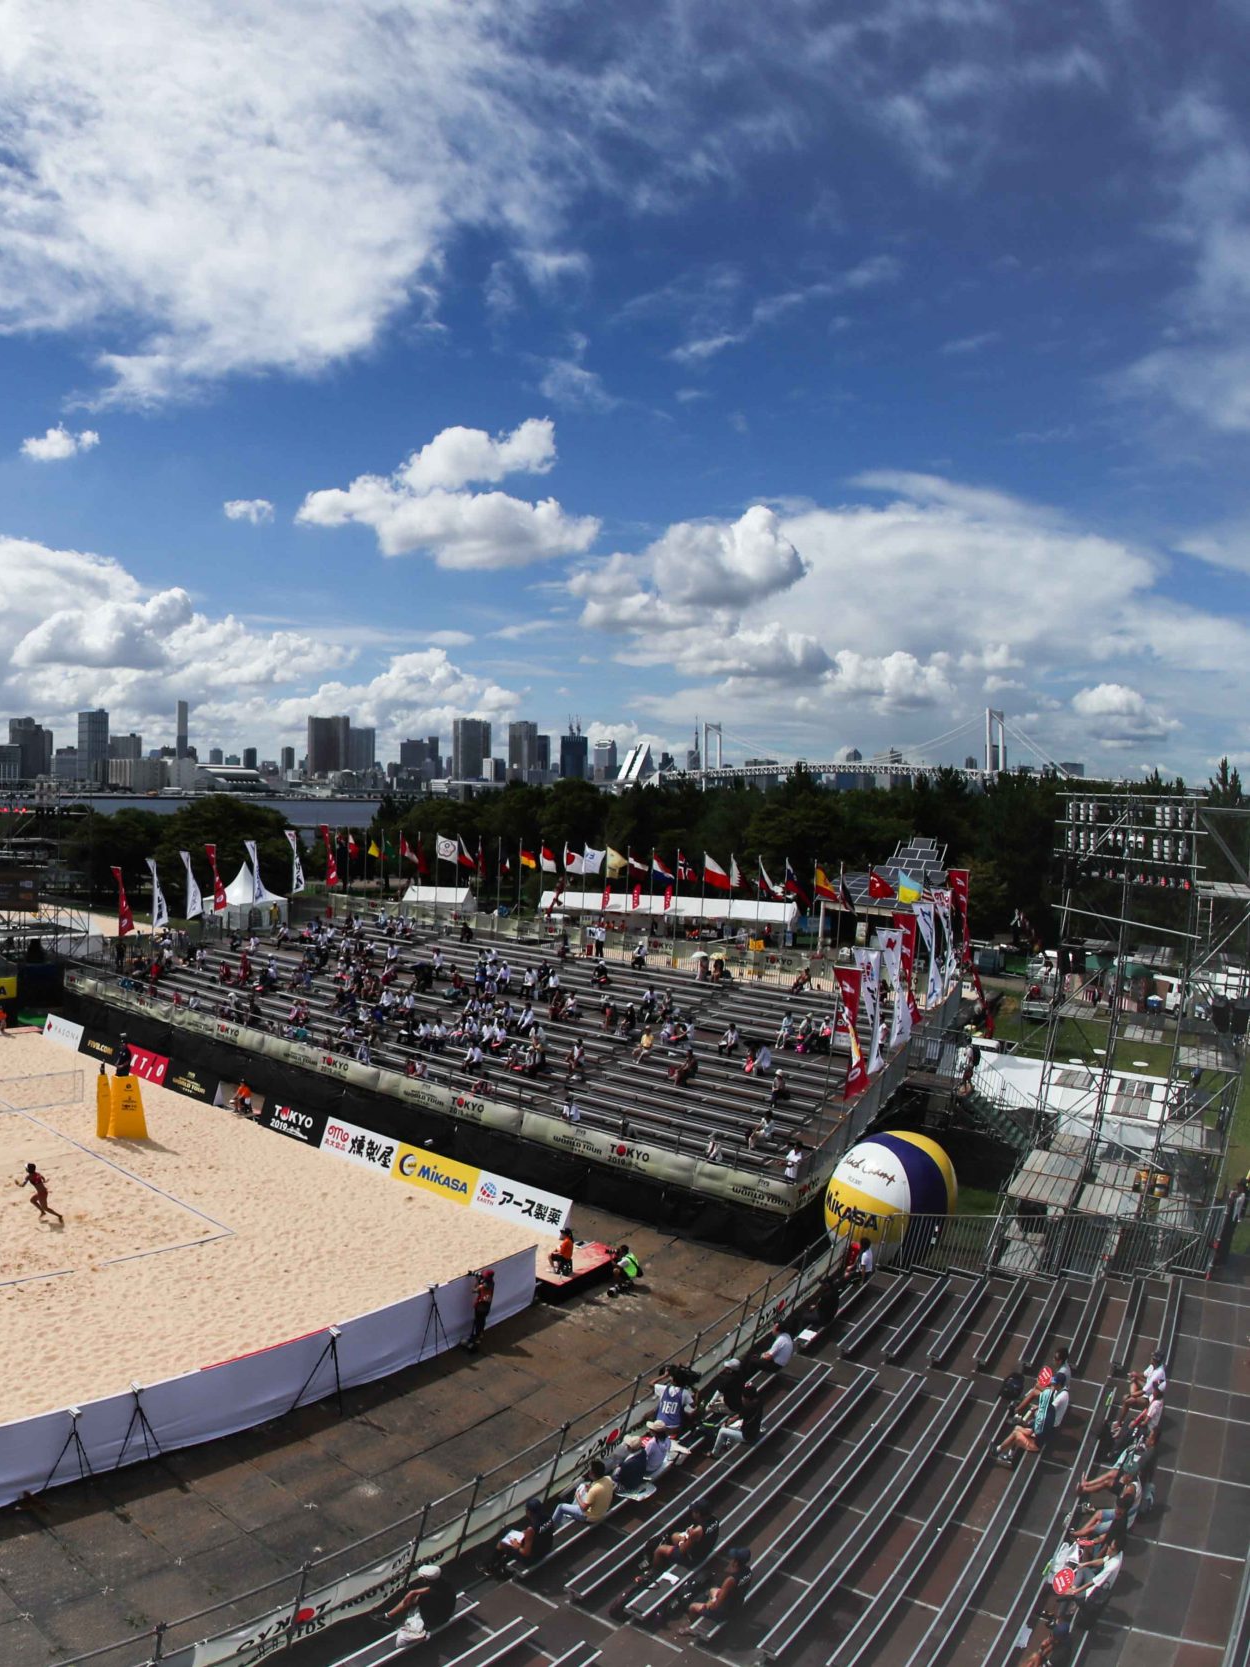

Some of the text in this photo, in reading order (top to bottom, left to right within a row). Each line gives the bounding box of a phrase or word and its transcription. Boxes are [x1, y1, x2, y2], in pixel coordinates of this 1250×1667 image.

[216, 1023, 240, 1038] TOKYO
[130, 1053, 165, 1080] KTIO
[321, 1055, 349, 1071] TOKYO
[426, 1096, 445, 1107] TOUR
[451, 1096, 485, 1113] TOKYO
[269, 1118, 287, 1132] 2019
[274, 1104, 314, 1129] TOKYO
[553, 1135, 581, 1148] WORLD
[581, 1143, 603, 1156] TOUR
[609, 1143, 650, 1163] TOKYO
[607, 1155, 626, 1166] 2019
[417, 1165, 468, 1195] MIKASA
[732, 1185, 764, 1201] WORLD
[765, 1195, 791, 1208] TOUR
[498, 1190, 563, 1226] アース製薬
[826, 1189, 878, 1232] MIKASA
[660, 1401, 677, 1415] 160
